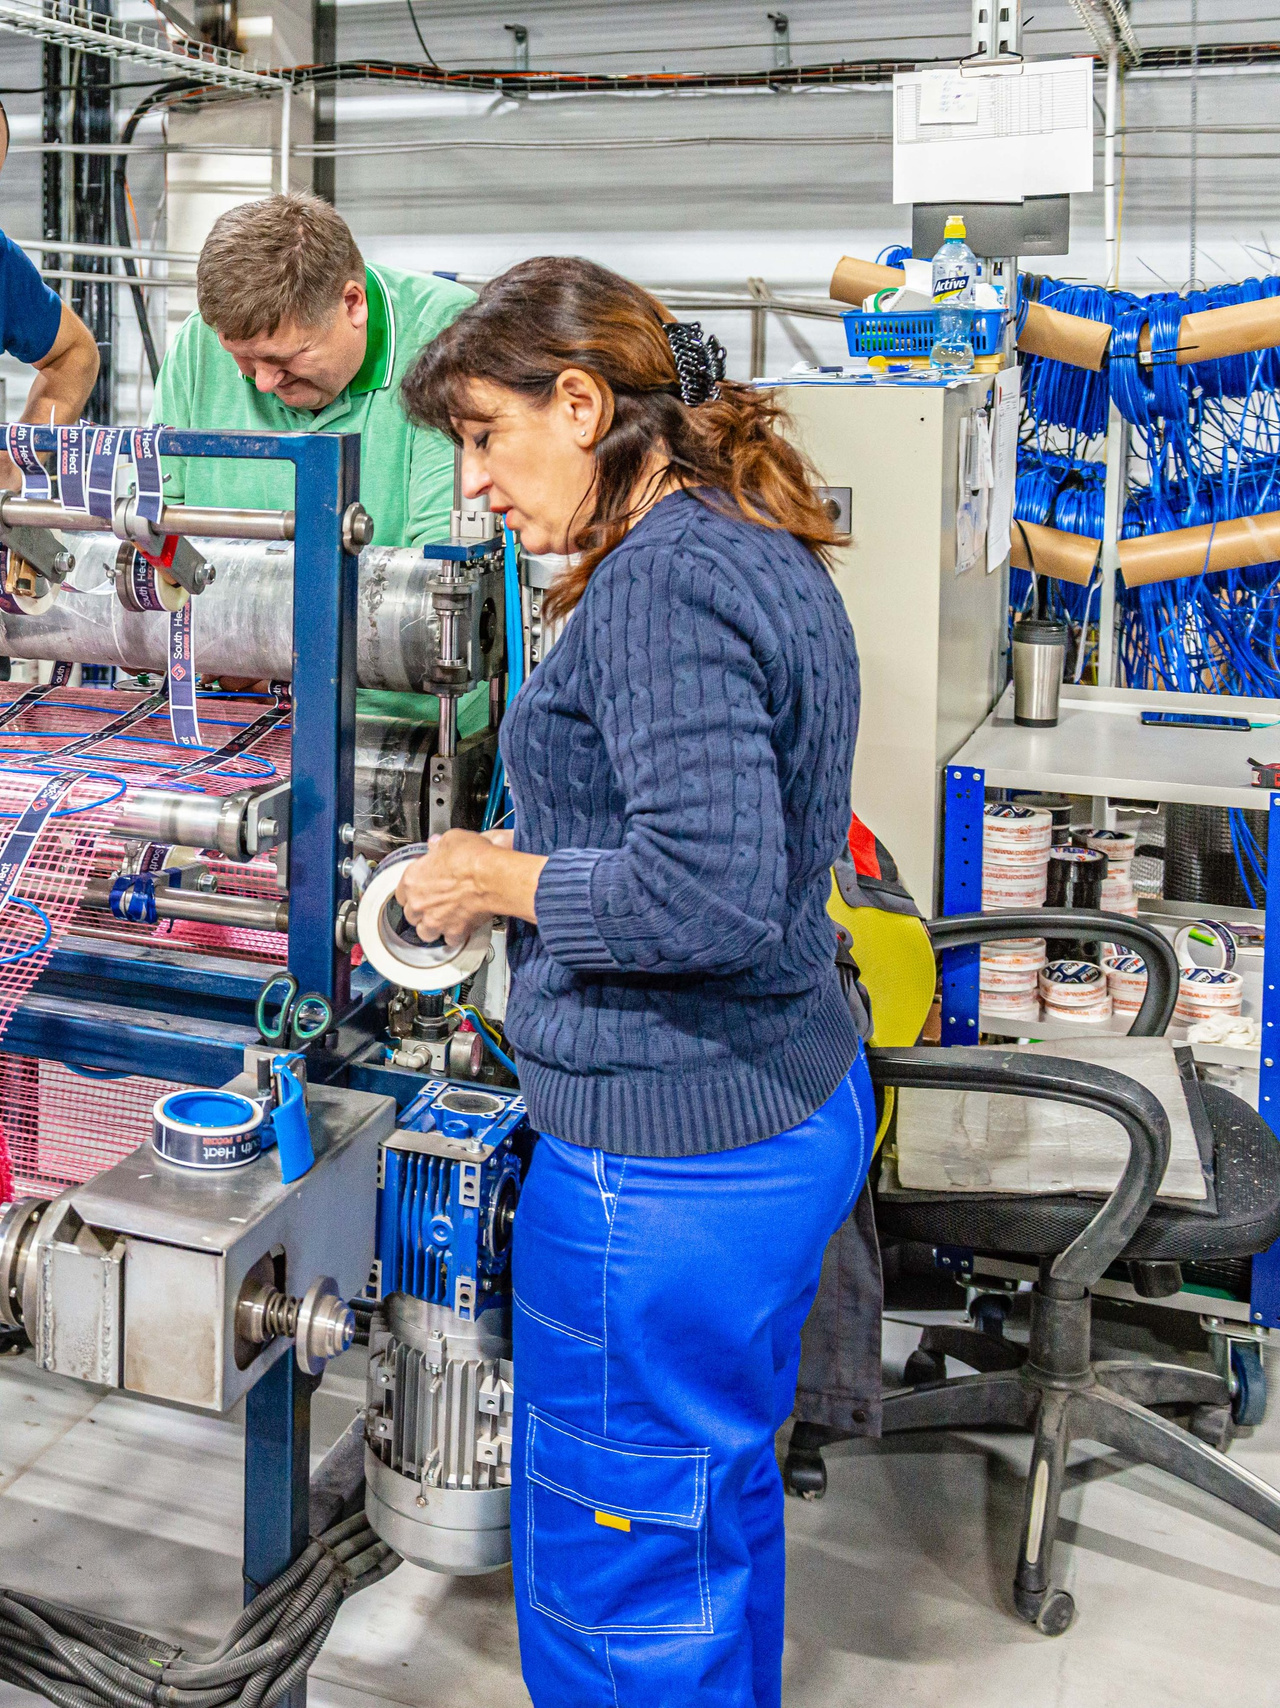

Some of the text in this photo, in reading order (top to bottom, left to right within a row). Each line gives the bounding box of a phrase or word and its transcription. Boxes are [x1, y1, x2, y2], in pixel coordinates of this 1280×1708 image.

[935, 279, 966, 292] Active
[102, 429, 117, 456] Heat
[142, 432, 154, 459] Heat
[18, 445, 33, 466] Heat
[69, 448, 79, 475] Heat
[138, 585, 153, 607] South
[173, 607, 183, 660] South Hea
[55, 665, 66, 684] outh
[203, 1146, 236, 1160] Heat
